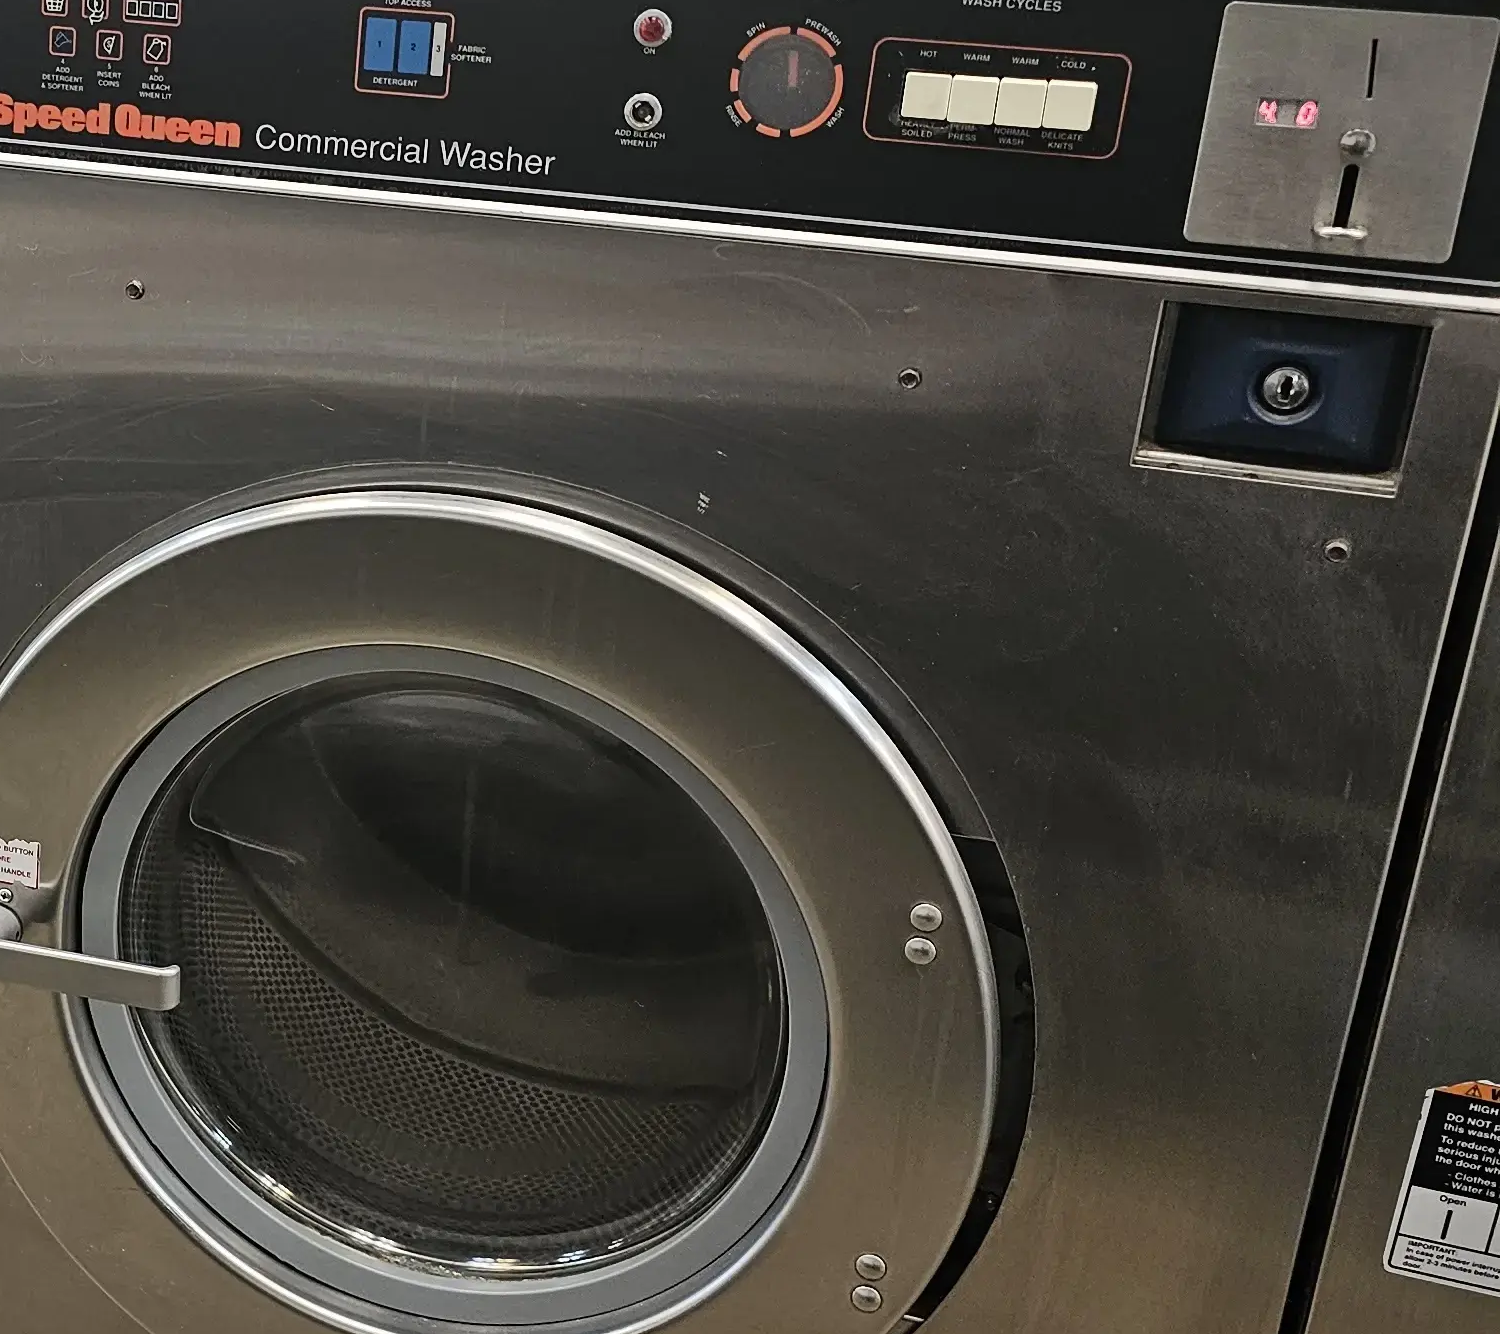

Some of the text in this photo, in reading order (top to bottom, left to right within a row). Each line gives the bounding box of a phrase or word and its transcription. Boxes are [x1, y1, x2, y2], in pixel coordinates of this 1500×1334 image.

[401, 0, 432, 8] ACCESS
[746, 22, 766, 38] SPIN
[804, 18, 842, 47] PREWASH
[458, 45, 487, 54] FABRIC
[643, 47, 656, 55] ON
[920, 49, 938, 58] HOT
[451, 54, 492, 63] SOFTENER
[963, 53, 990, 62] WARM
[1012, 56, 1039, 66] WARM
[1060, 60, 1086, 70] COLD
[373, 77, 418, 87] DETERGENT
[725, 105, 742, 127] RINSE
[826, 106, 845, 128] WASH
[114, 101, 242, 149] Queen
[633, 131, 666, 139] BLEACH
[902, 129, 933, 138] SOILED
[948, 132, 976, 141] PRESS
[994, 127, 1031, 138] NORMAL
[1041, 131, 1083, 142] DELICATE
[620, 139, 644, 147] WHEN
[998, 137, 1024, 146] WASH
[1047, 141, 1074, 151] KNITS
[255, 124, 556, 175] Commercial Washer
[4, 845, 34, 856] BUTTON
[1, 867, 31, 878] HANDLE
